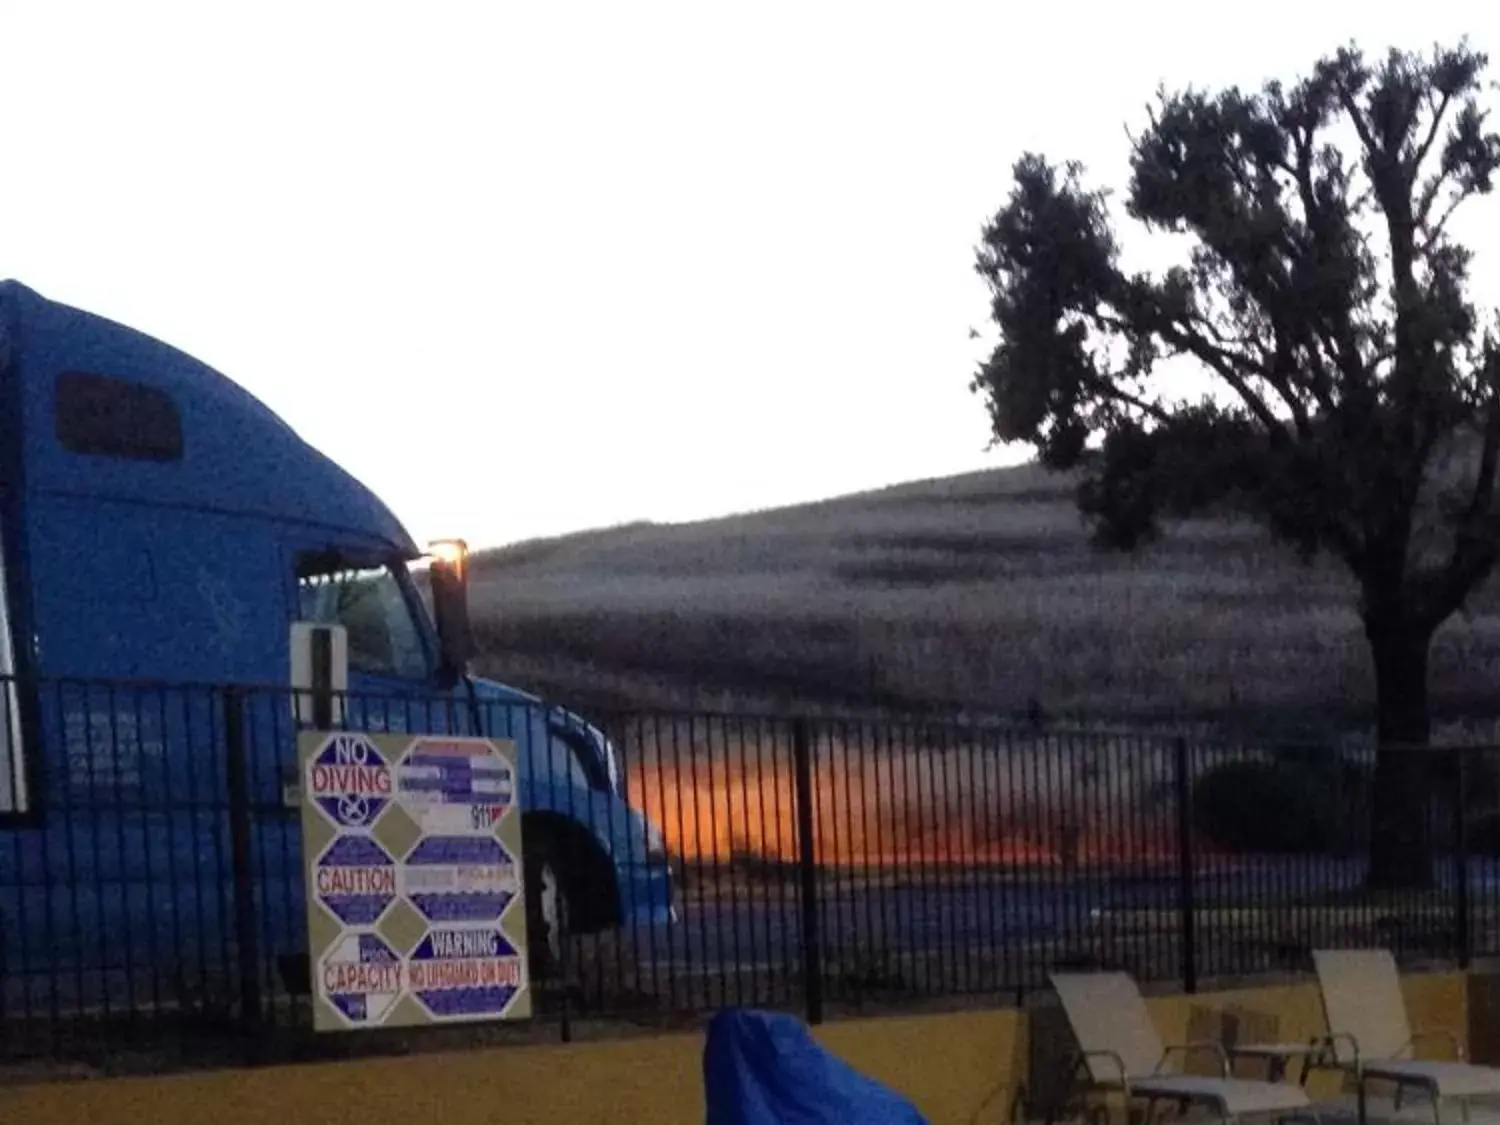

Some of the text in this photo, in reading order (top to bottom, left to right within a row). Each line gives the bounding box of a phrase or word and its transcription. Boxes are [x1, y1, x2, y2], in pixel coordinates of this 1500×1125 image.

[335, 737, 368, 765] NO
[312, 765, 391, 794] DIVING
[318, 867, 396, 893] CAUTION
[431, 929, 498, 957] WARNING
[324, 964, 402, 992] CAPACITY
